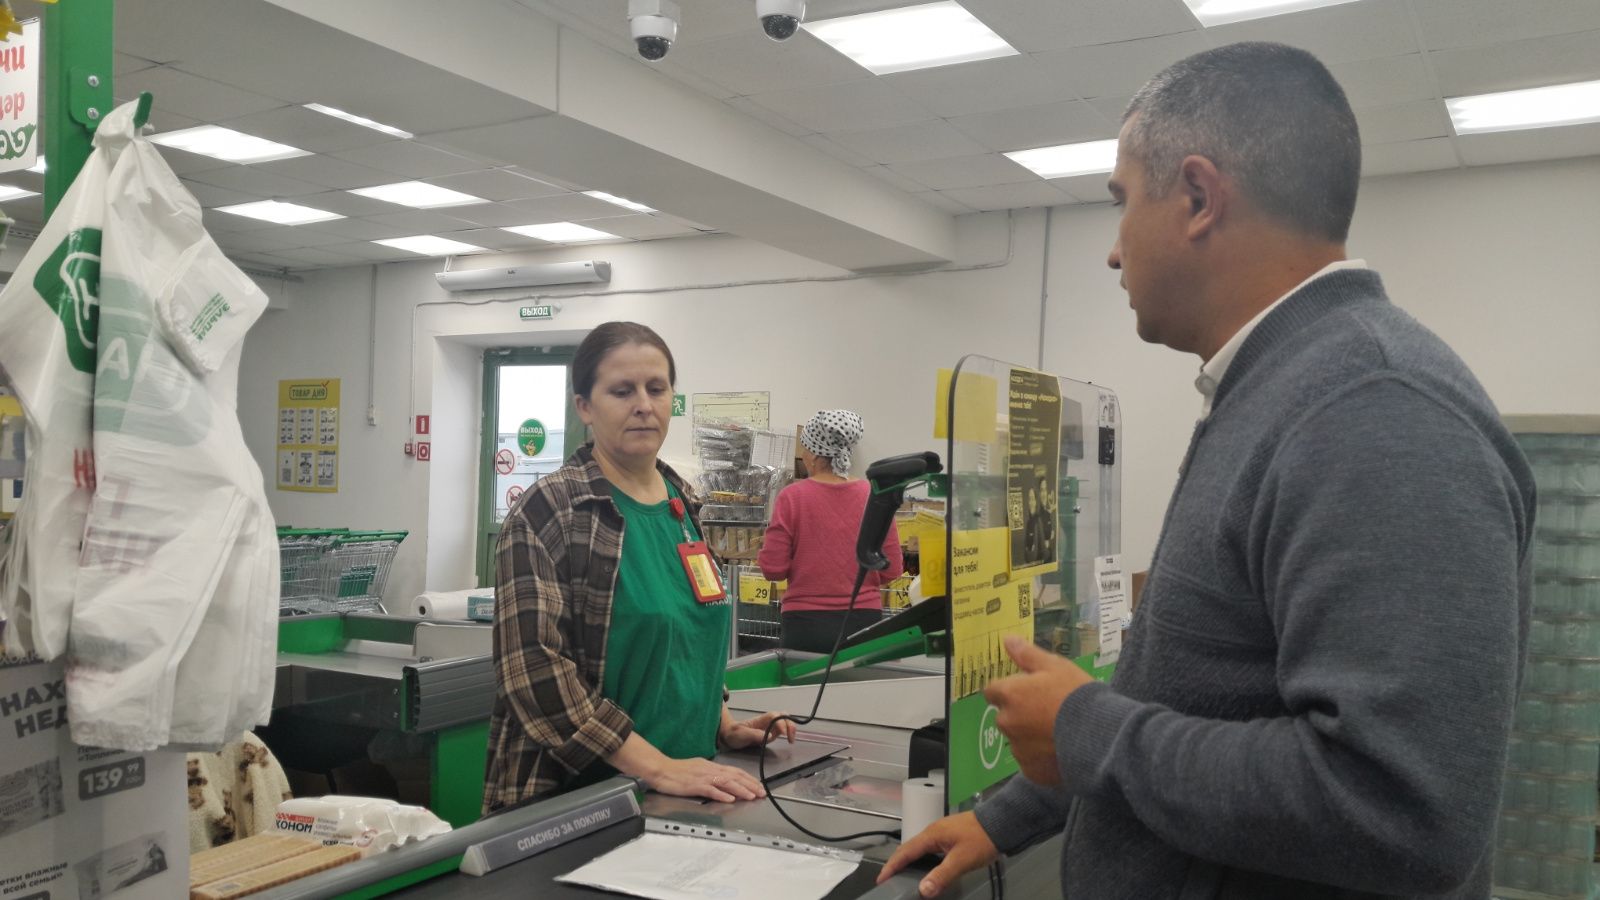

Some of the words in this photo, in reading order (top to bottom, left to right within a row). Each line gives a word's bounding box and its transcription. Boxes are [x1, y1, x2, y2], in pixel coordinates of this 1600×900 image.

[522, 306, 549, 317] ВЫХОД
[520, 426, 543, 435] ВЫХОД
[0, 680, 66, 717] НАХ
[83, 767, 123, 795] 139
[127, 762, 140, 773] 99
[517, 827, 560, 851] СПАСИБО
[561, 821, 575, 835] ЗА
[573, 808, 611, 830] ПОКУПКУ
[24, 862, 68, 880] влажные
[3, 883, 27, 895] всей
[29, 873, 64, 888] семьи»
